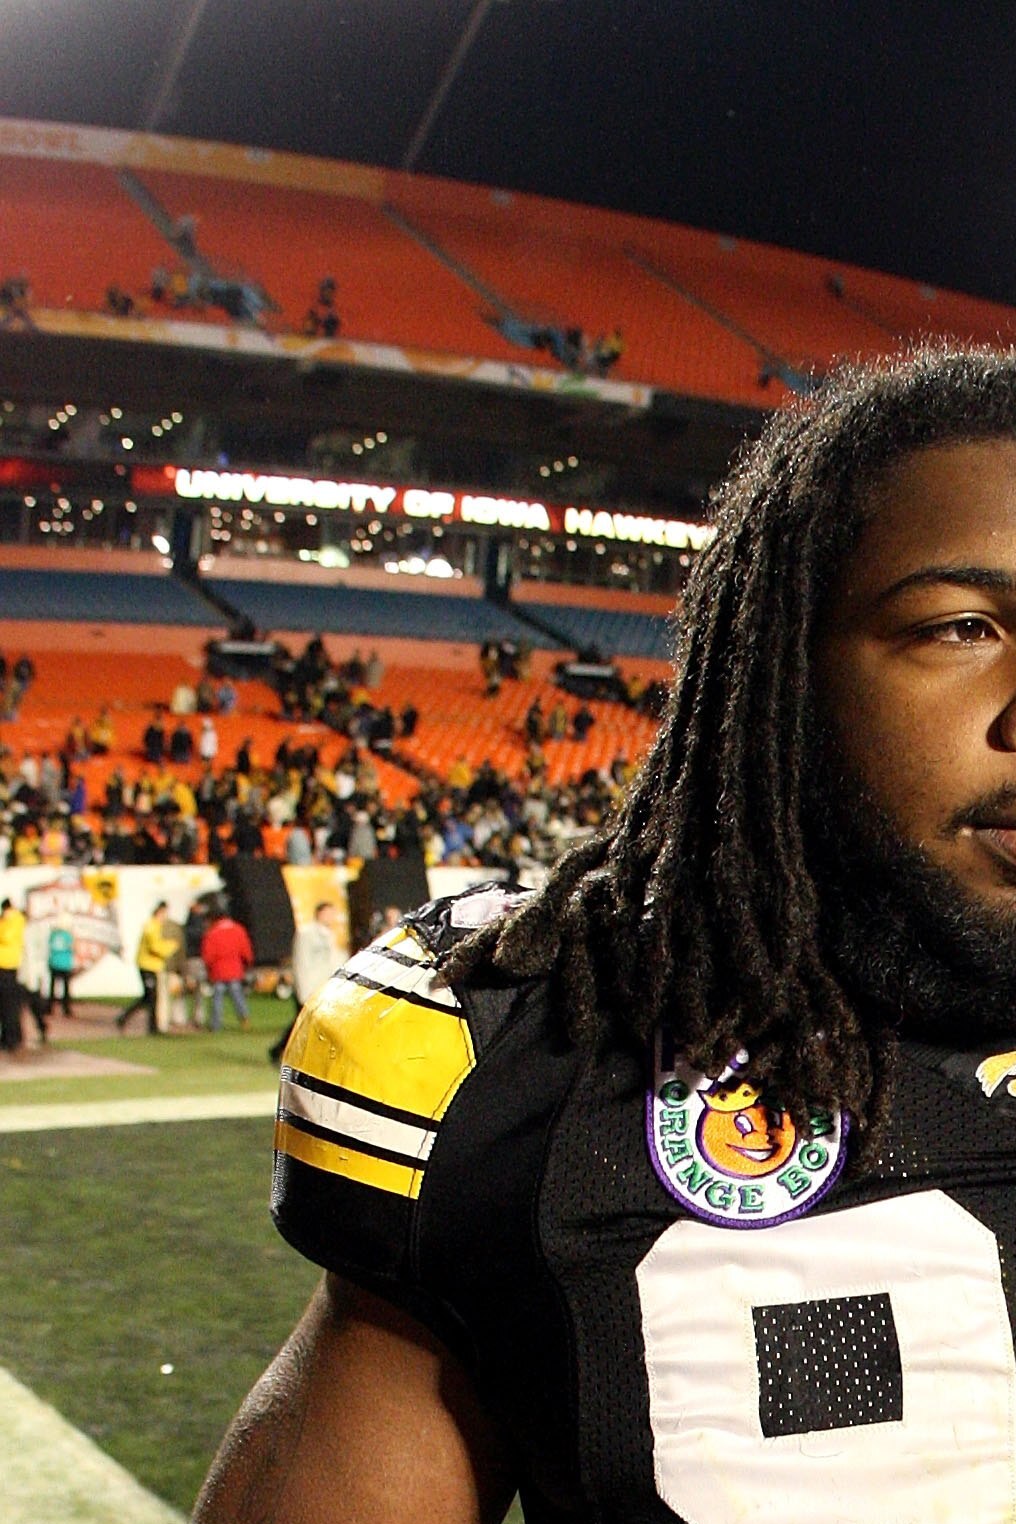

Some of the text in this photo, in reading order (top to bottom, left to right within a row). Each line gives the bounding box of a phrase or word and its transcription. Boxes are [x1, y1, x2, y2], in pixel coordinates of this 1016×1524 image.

[174, 468, 719, 551] UNIVERSITY OF IOWA HAWKEY
[659, 1079, 836, 1214] ORANGE BOW
